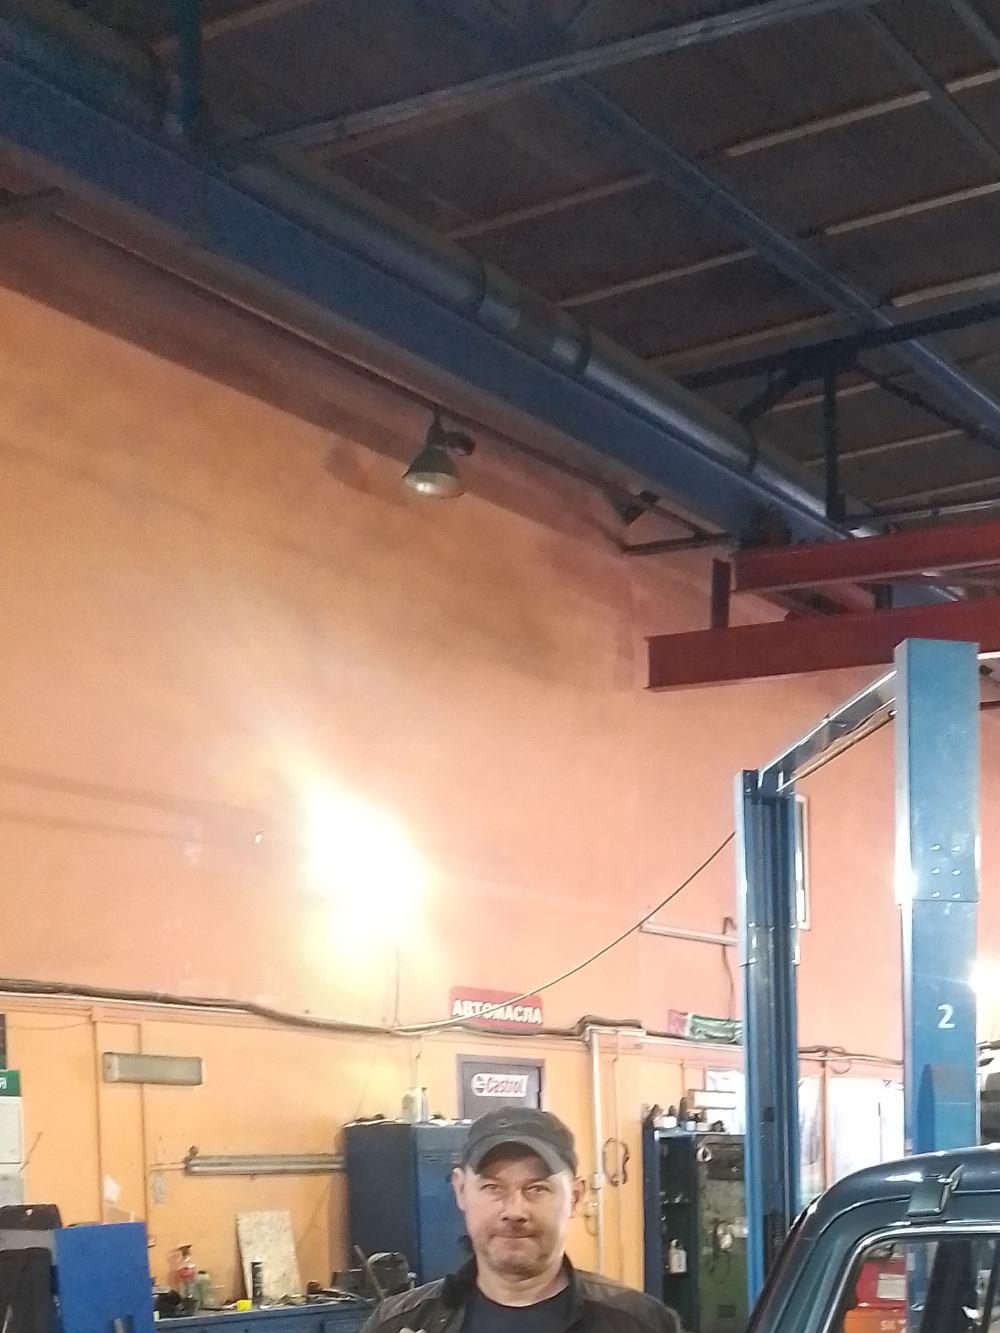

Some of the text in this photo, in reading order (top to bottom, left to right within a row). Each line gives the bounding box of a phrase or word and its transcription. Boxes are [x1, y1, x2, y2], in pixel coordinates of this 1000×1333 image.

[451, 998, 543, 1024] АВТОМАСЛА
[937, 1003, 956, 1029] 2
[486, 1075, 524, 1095] Castrol
